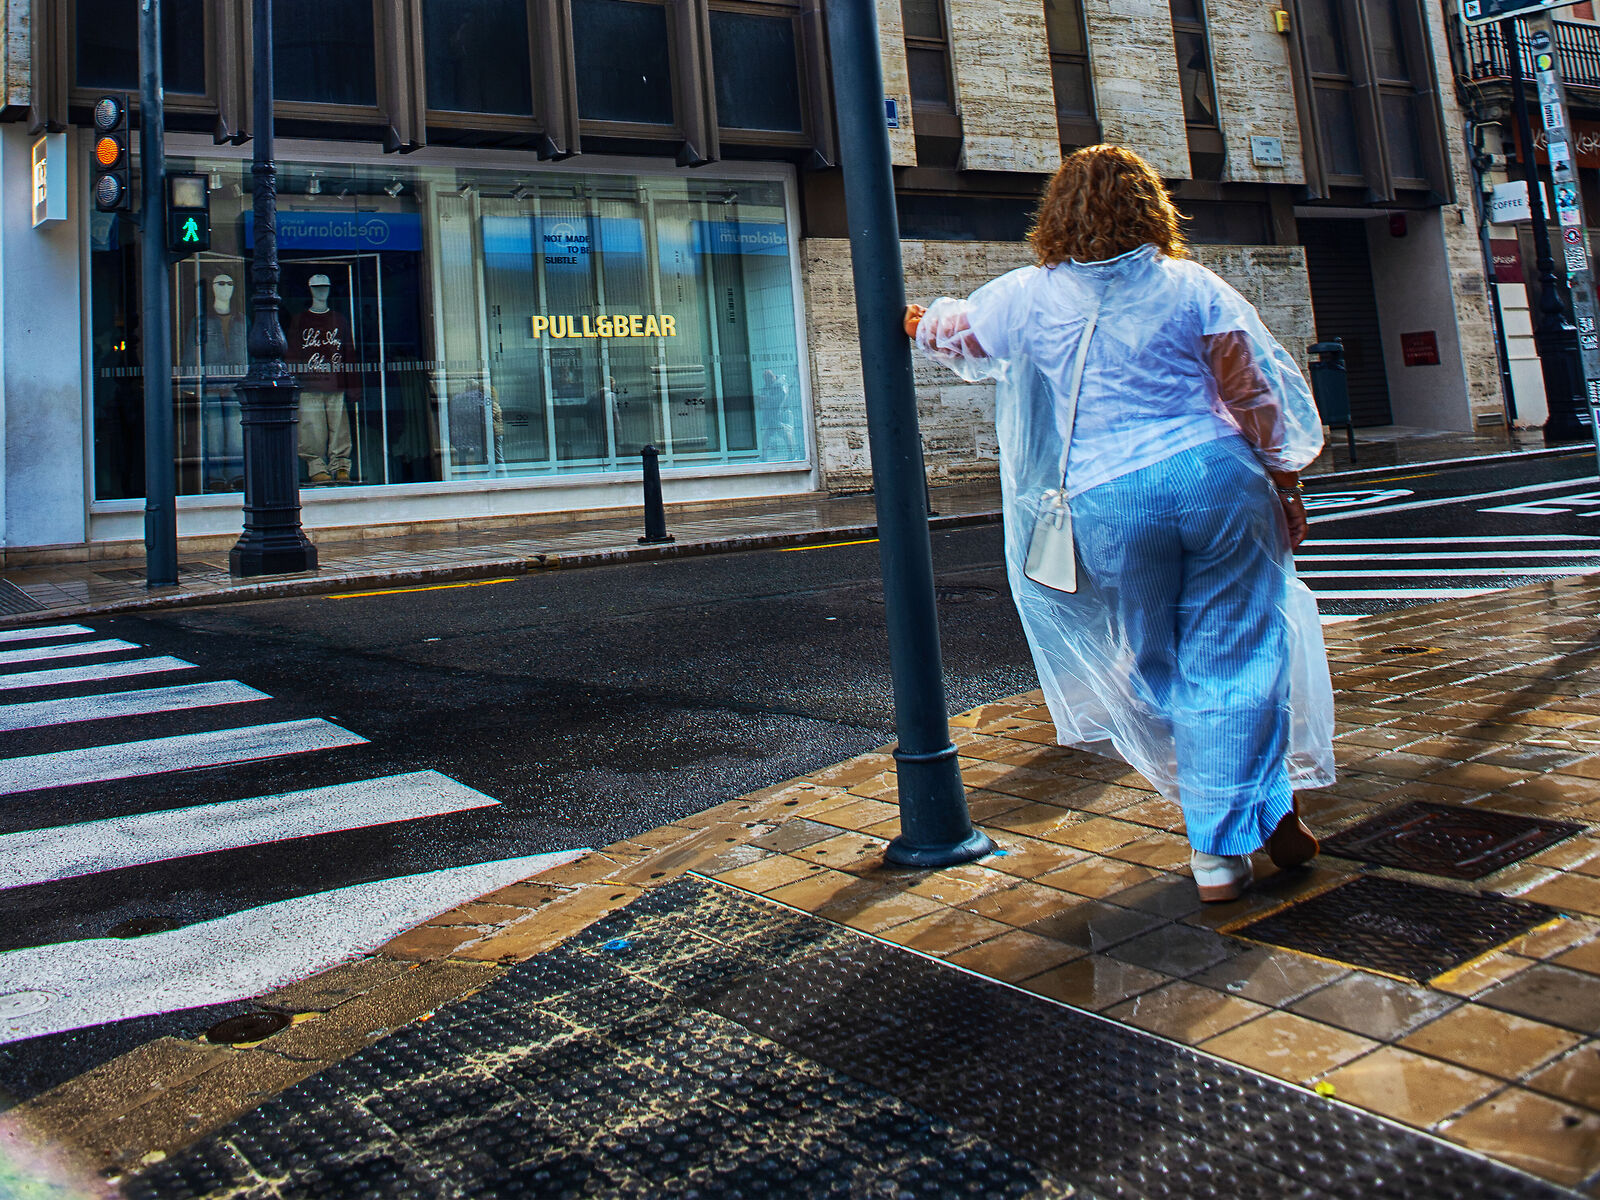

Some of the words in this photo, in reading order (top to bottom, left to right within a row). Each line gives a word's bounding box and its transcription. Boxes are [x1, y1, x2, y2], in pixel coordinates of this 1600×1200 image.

[1493, 199, 1522, 210] COFFEE
[543, 234, 561, 243] NOT
[566, 234, 591, 243] MADE
[567, 246, 579, 254] TO
[580, 246, 592, 254] BE
[544, 256, 578, 265] SUBTLE
[532, 314, 677, 339] PULL&BEAR
